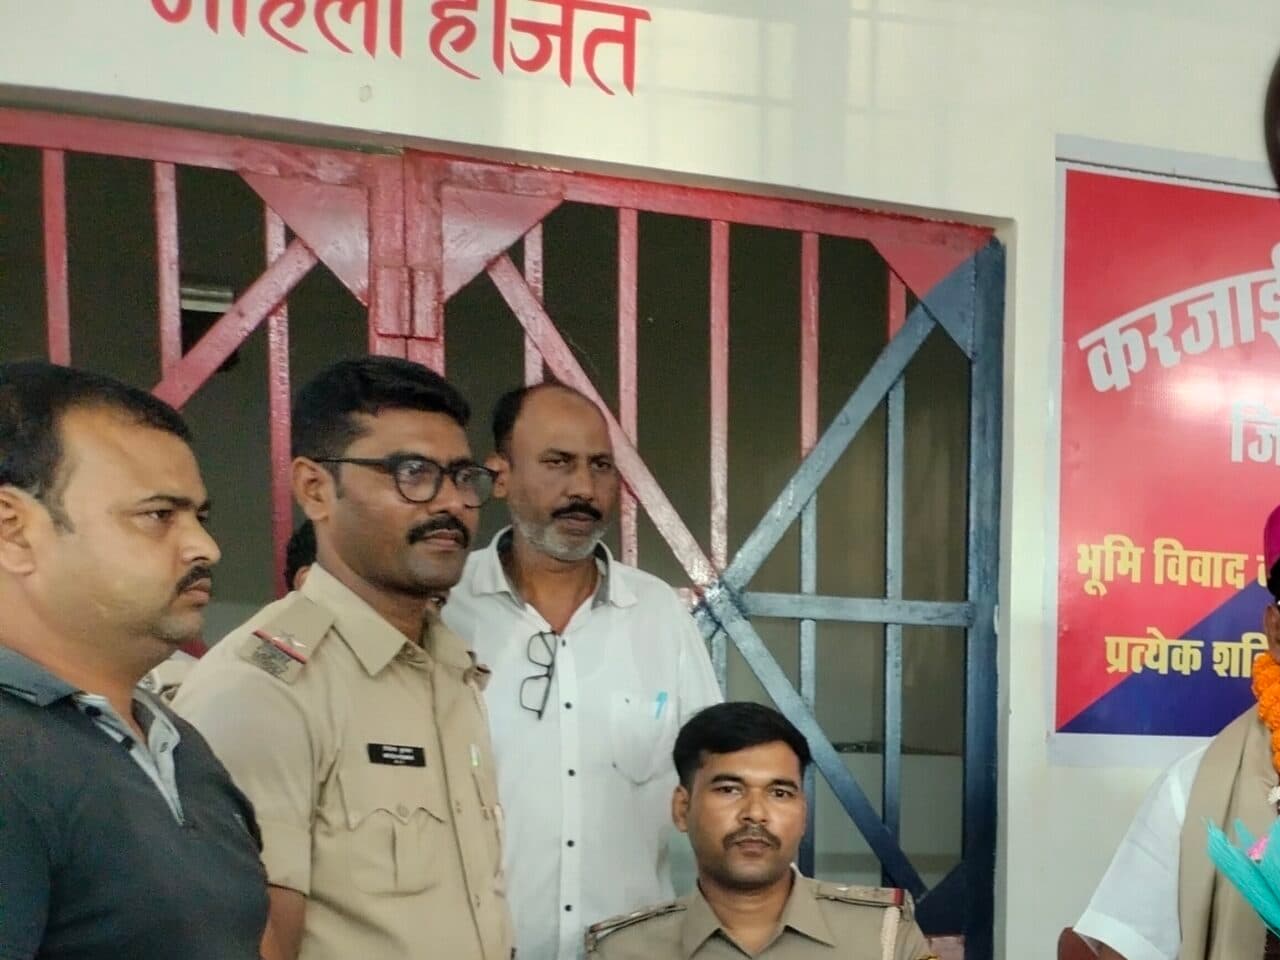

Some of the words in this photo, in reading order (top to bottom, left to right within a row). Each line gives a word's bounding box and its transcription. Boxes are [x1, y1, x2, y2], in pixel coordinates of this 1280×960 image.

[429, 0, 652, 96] हाजत
[1076, 533, 1146, 597] भूमि
[1153, 537, 1249, 590] विवाद
[1104, 626, 1205, 676] प्रत्येक
